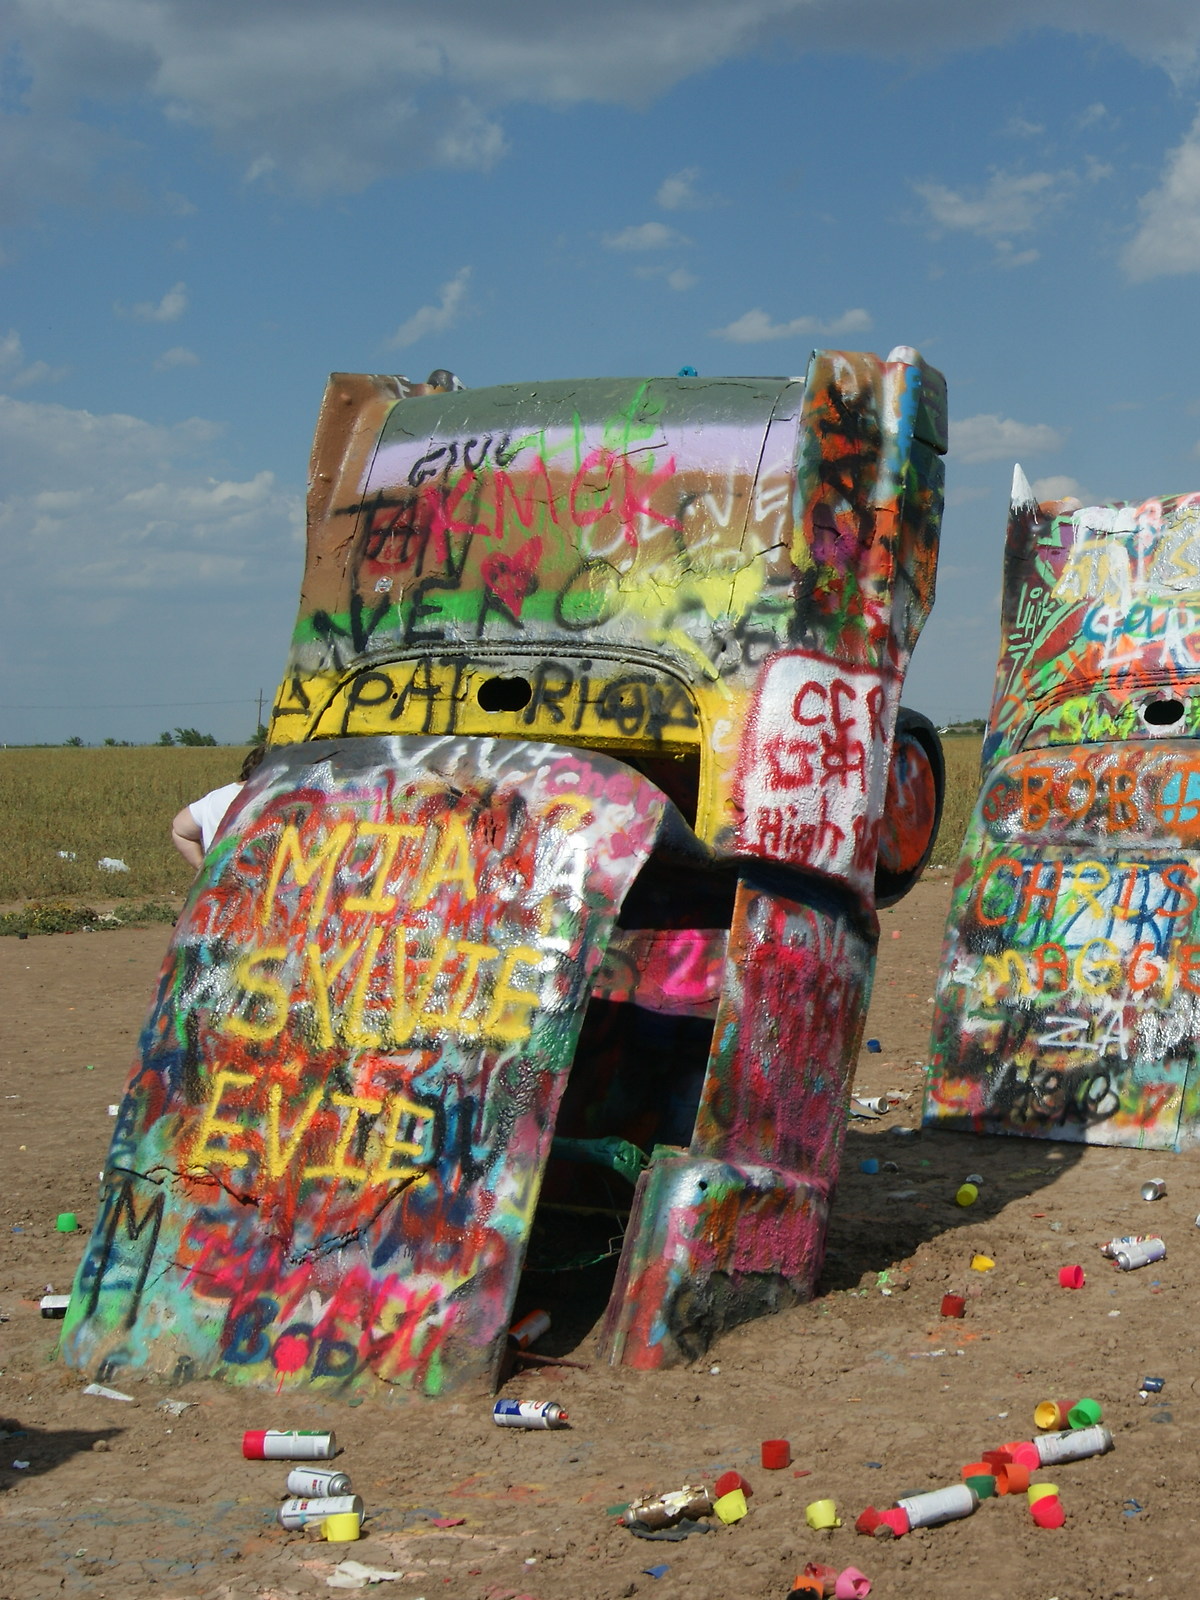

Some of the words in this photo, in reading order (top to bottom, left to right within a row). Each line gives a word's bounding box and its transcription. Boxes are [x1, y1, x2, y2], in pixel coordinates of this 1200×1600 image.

[262, 815, 478, 925] MIA
[975, 857, 1199, 927] CHRIS
[222, 923, 544, 1050] SYLVIE
[186, 1071, 435, 1187] EVIE
